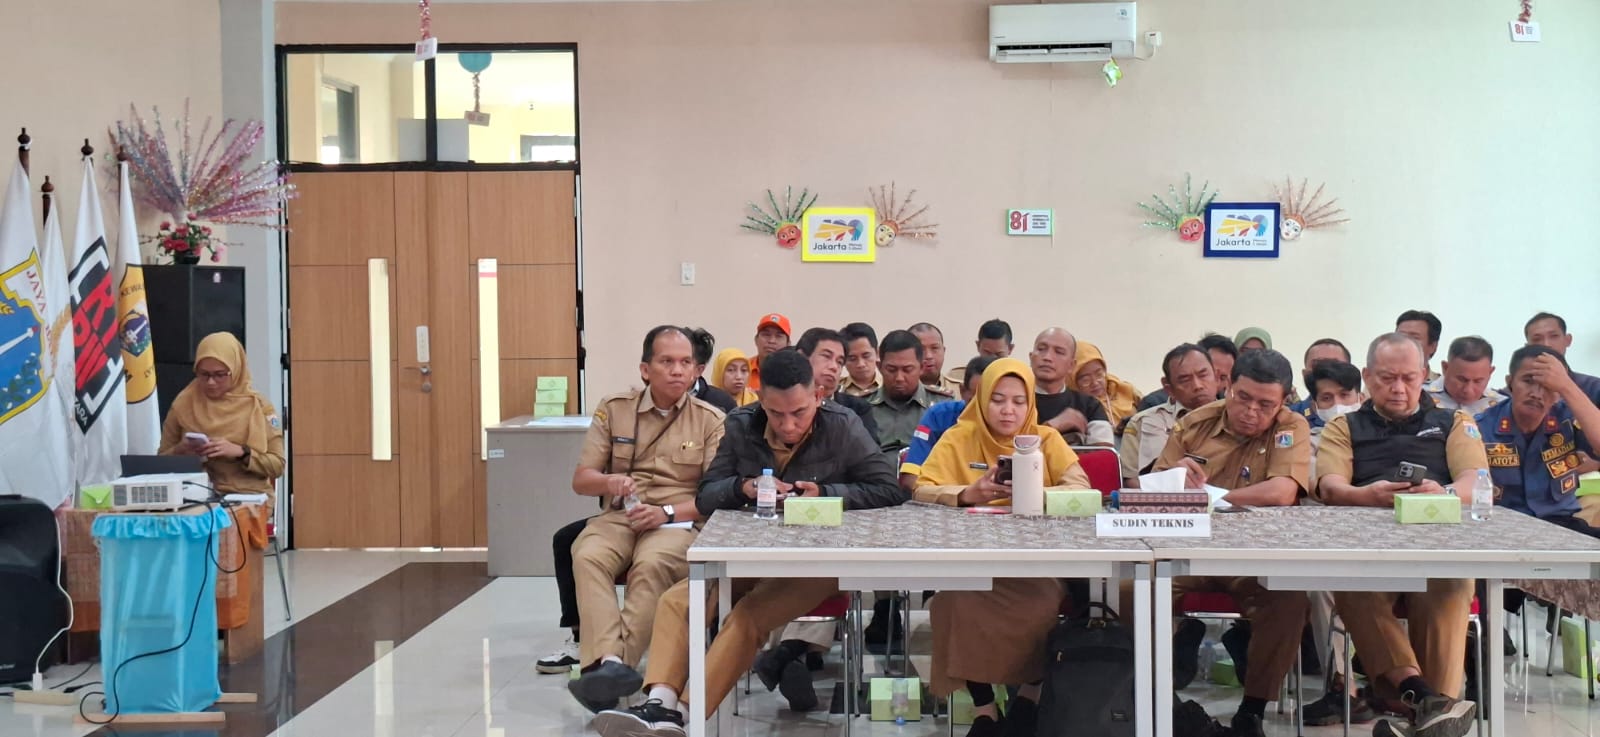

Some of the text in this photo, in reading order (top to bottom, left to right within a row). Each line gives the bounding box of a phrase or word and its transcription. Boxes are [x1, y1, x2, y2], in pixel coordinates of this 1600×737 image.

[1010, 210, 1030, 232] 81
[1216, 238, 1251, 246] Jakarta
[1112, 519, 1194, 528] SUDIN TEKNIS
